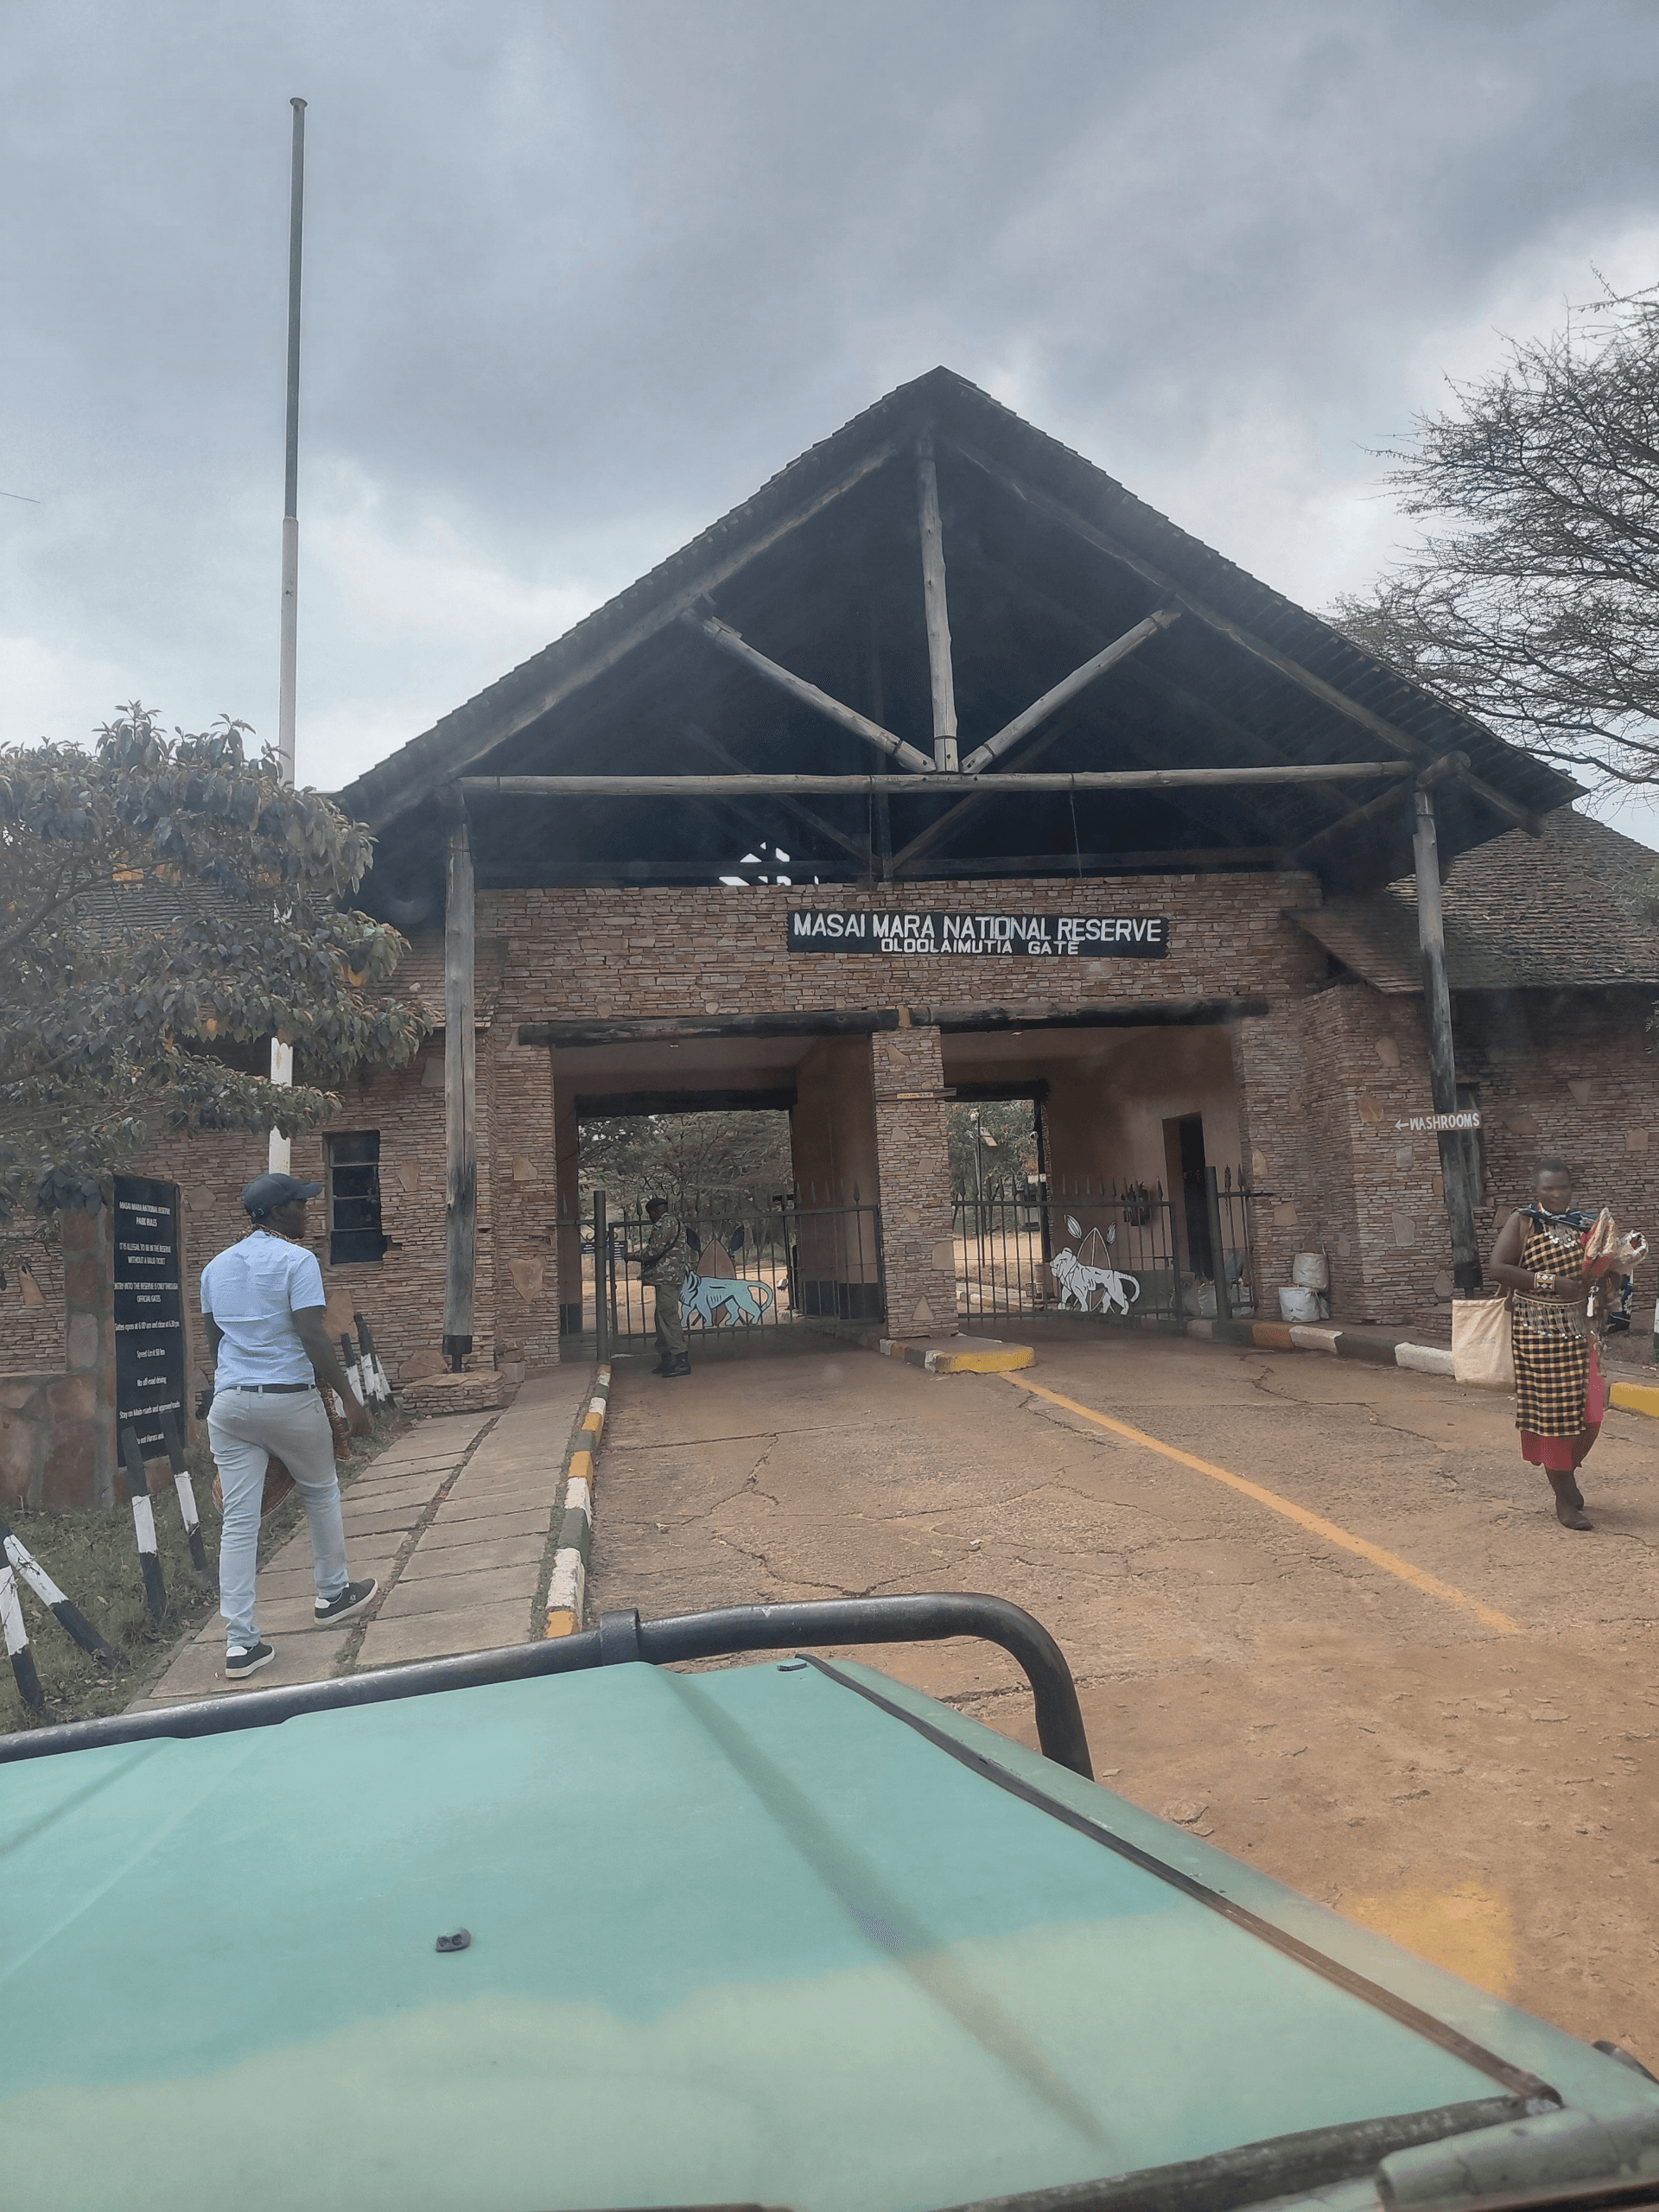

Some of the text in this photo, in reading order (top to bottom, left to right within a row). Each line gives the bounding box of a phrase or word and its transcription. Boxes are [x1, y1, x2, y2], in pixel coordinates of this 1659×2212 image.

[793, 912, 1162, 942] MASAI MARA NATIONAL RESERVE
[880, 938, 1080, 955] OLOOLAIMUTIA GATE
[1409, 1112, 1480, 1131] WASHROOMS
[142, 1205, 158, 1214] NATIONAL
[136, 1217, 158, 1228] PARK RULES
[127, 1243, 141, 1251] ILLEGAL
[127, 1255, 144, 1264] WITHOUT
[147, 1256, 156, 1265] VALID
[137, 1294, 162, 1303] OFFICIAL GATES
[137, 1350, 148, 1359] Speed
[119, 1410, 128, 1420] Stay
